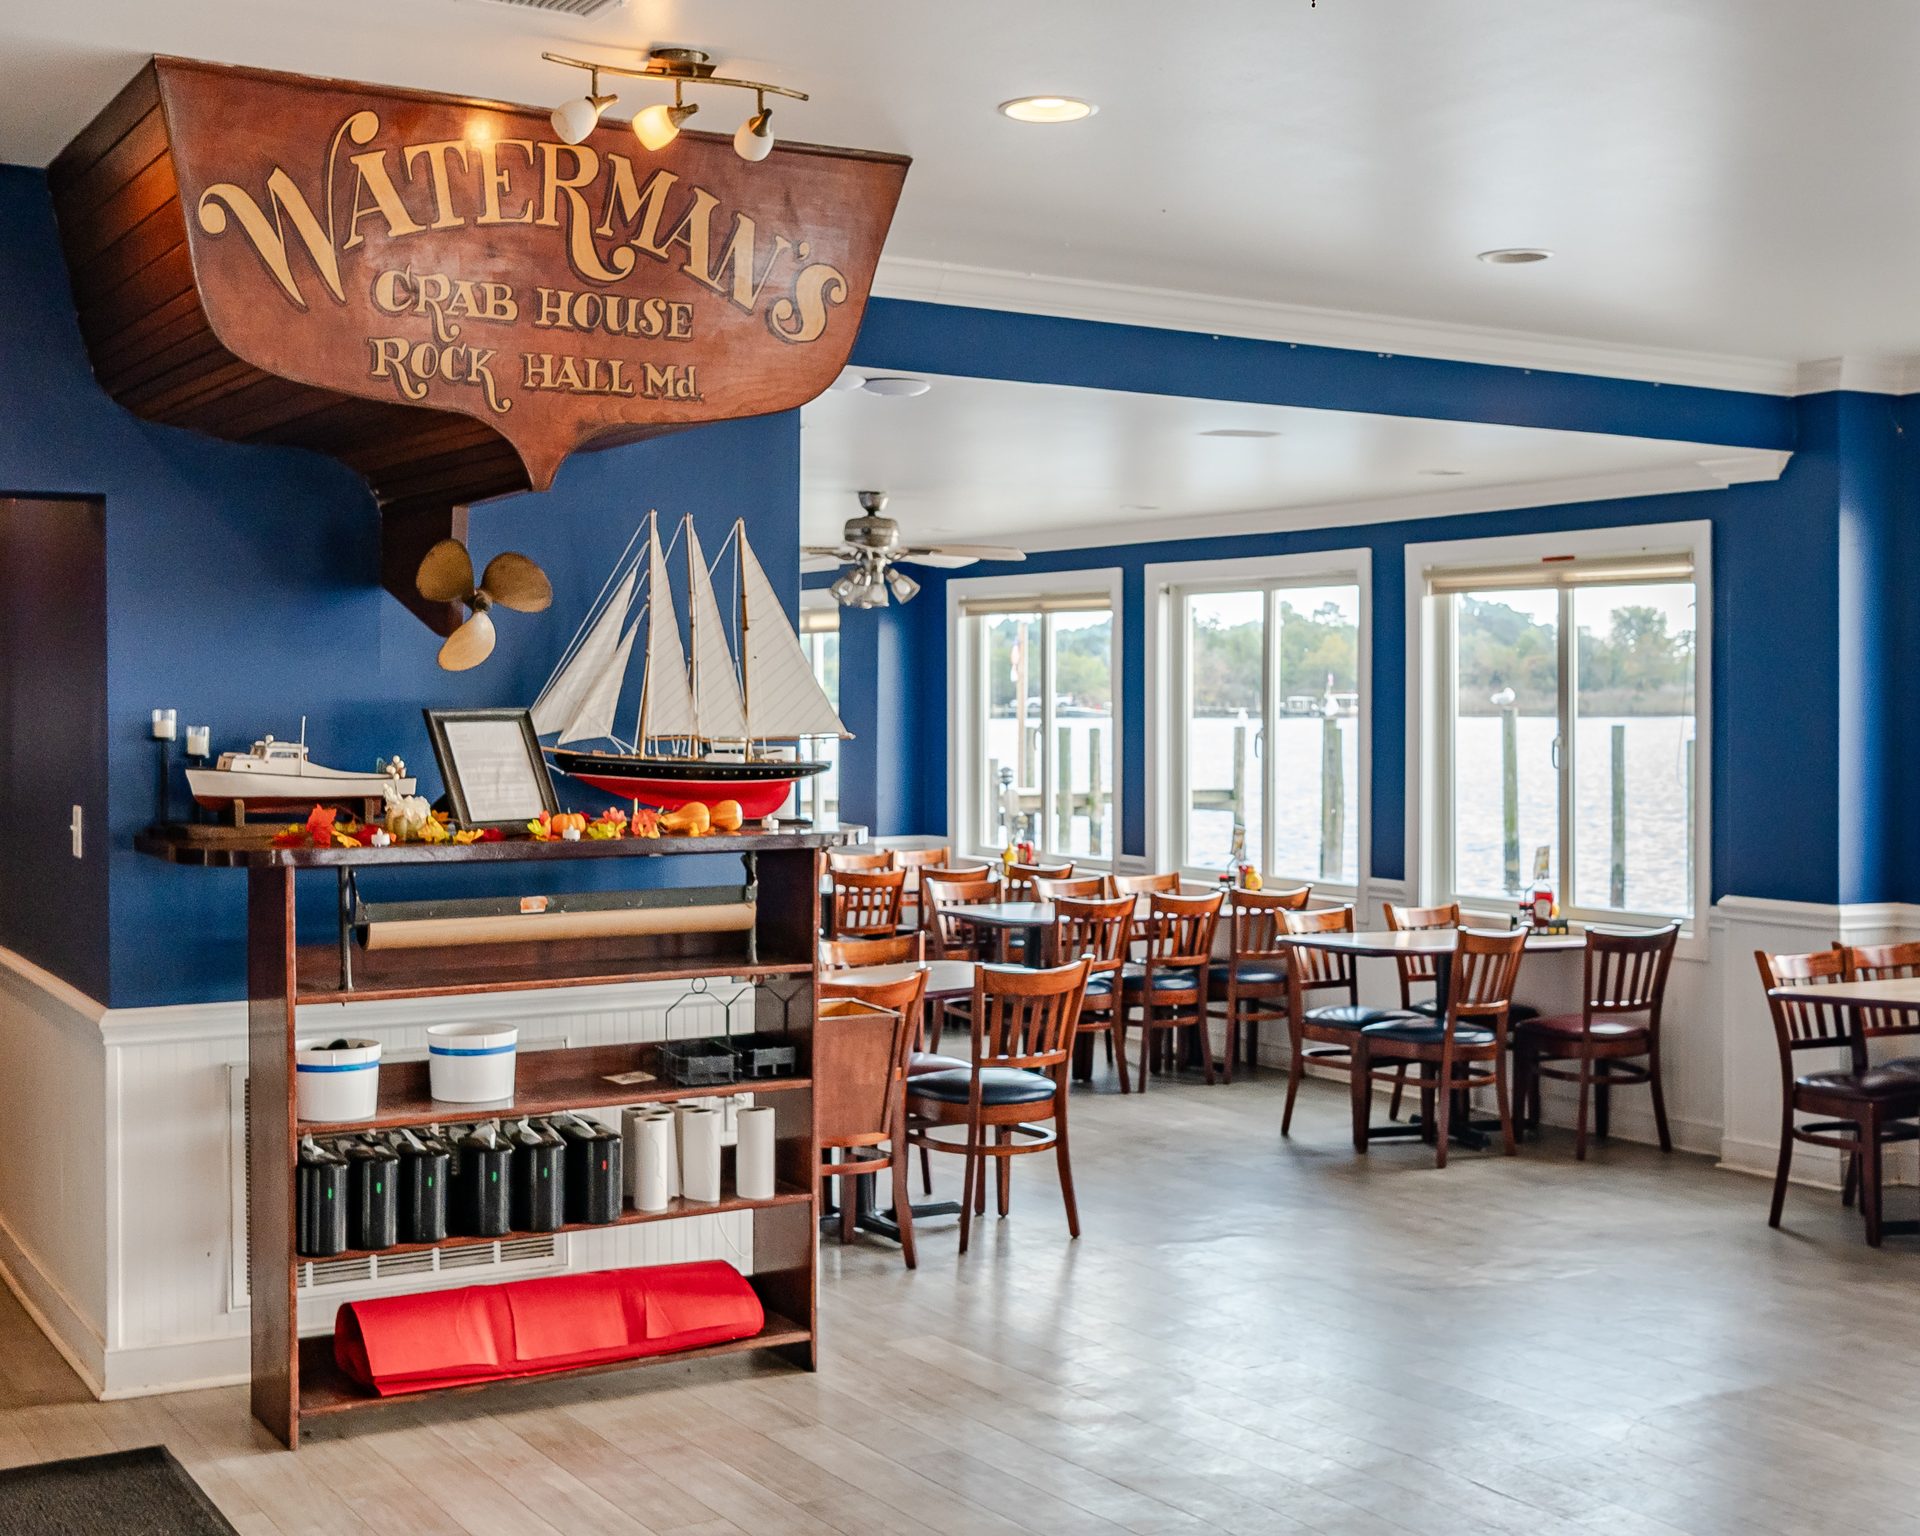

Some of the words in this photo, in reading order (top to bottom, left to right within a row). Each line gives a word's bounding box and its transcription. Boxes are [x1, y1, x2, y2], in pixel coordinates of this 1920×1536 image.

[198, 110, 847, 343] WATERMAN'S
[374, 265, 518, 343] CRAB
[535, 287, 694, 339] HOUSE
[369, 336, 512, 412] ROCK
[523, 353, 633, 394] HALL
